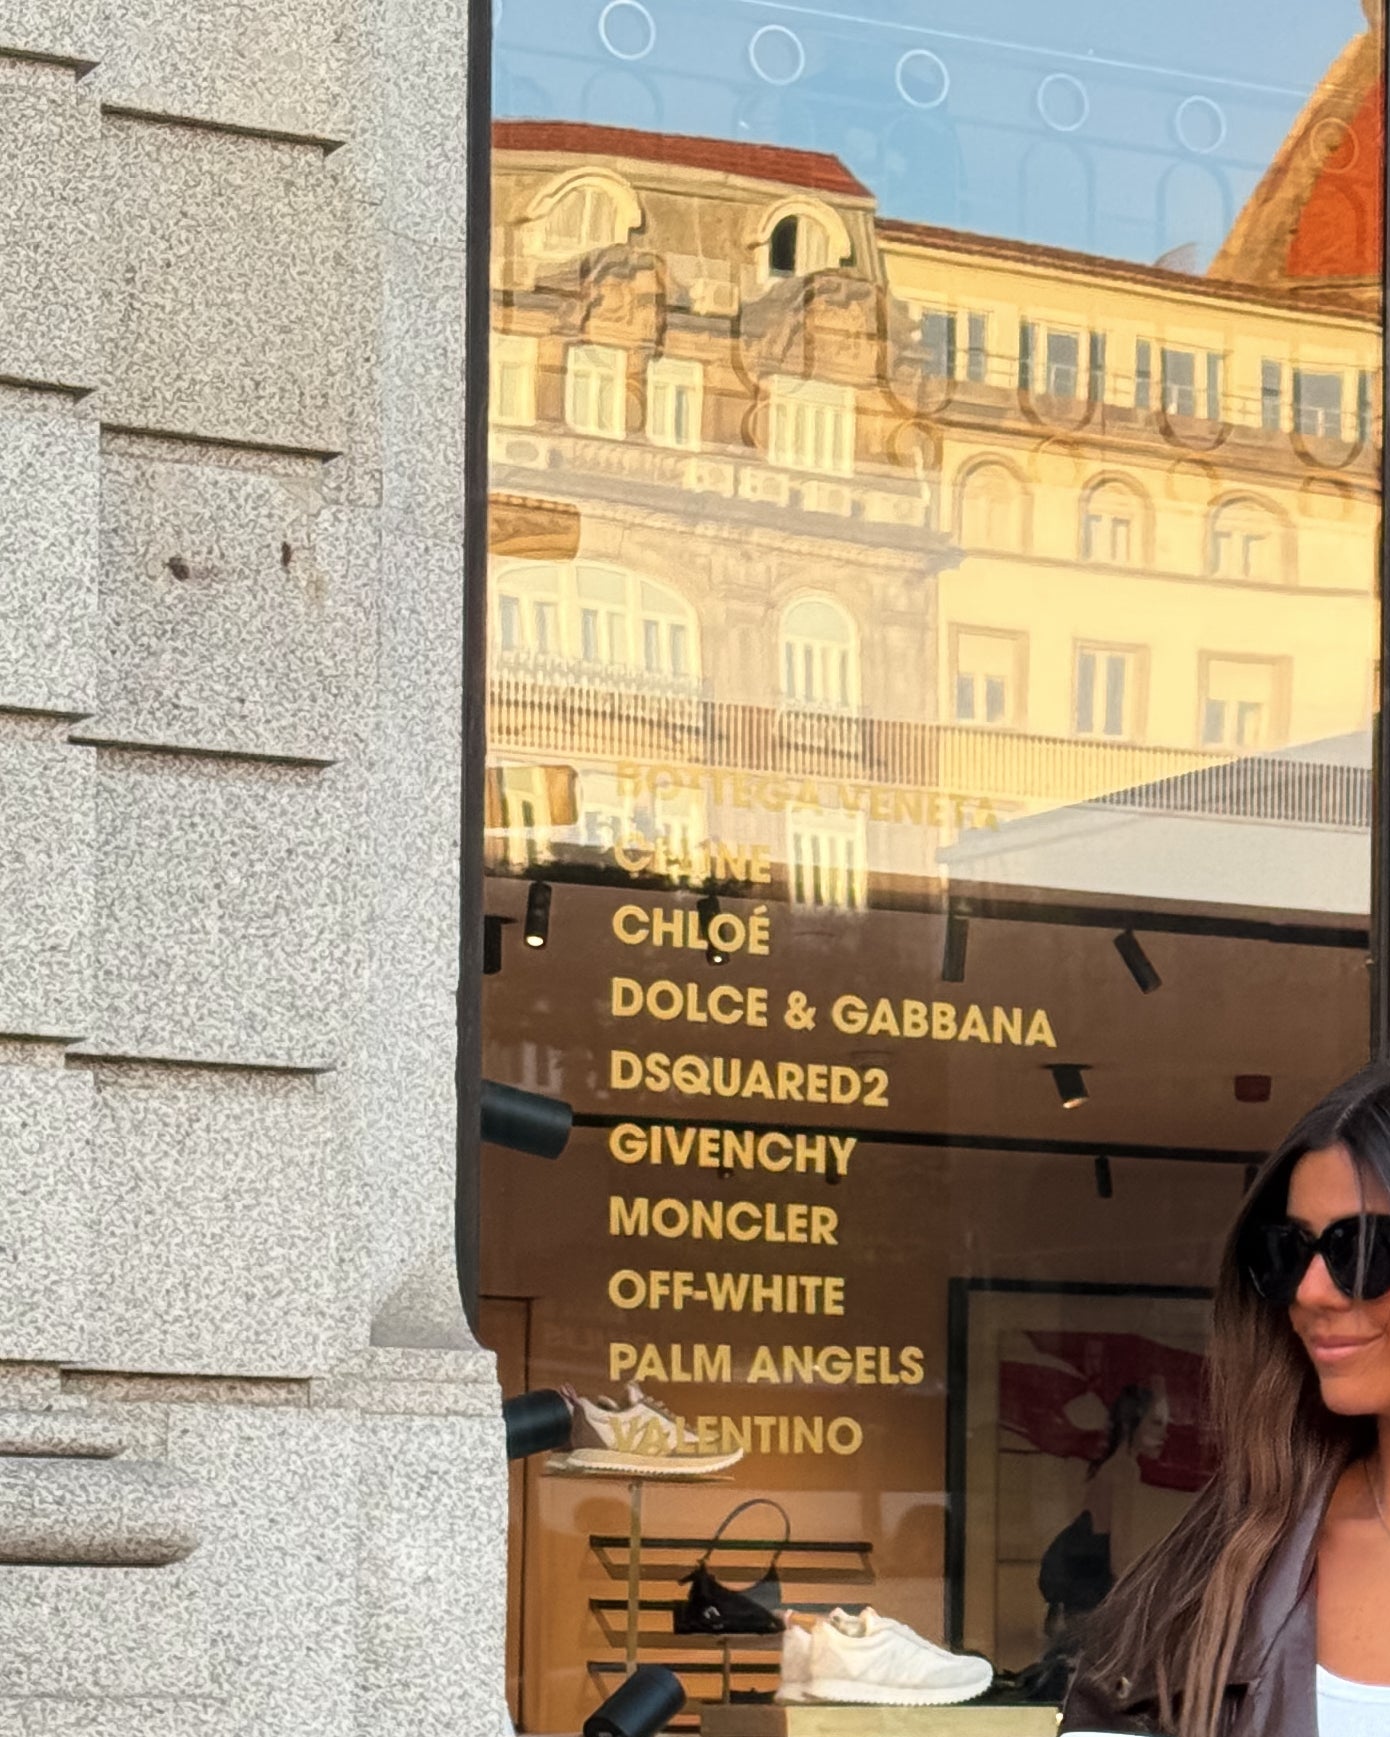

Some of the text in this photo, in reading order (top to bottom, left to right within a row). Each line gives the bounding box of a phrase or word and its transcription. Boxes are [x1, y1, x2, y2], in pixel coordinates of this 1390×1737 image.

[616, 760, 822, 814] BOTTEGA
[611, 904, 770, 955] CHLOÉ
[611, 977, 1057, 1048] DOLCE & GABBANA
[610, 1050, 889, 1107] DSQUARED2
[609, 1124, 857, 1175] GIVENCHY
[609, 1196, 838, 1245] MONCLER
[608, 1270, 845, 1315] OFF-WHITE
[609, 1342, 925, 1385] PALM ANGELS
[612, 1415, 863, 1456] VALENTINO
